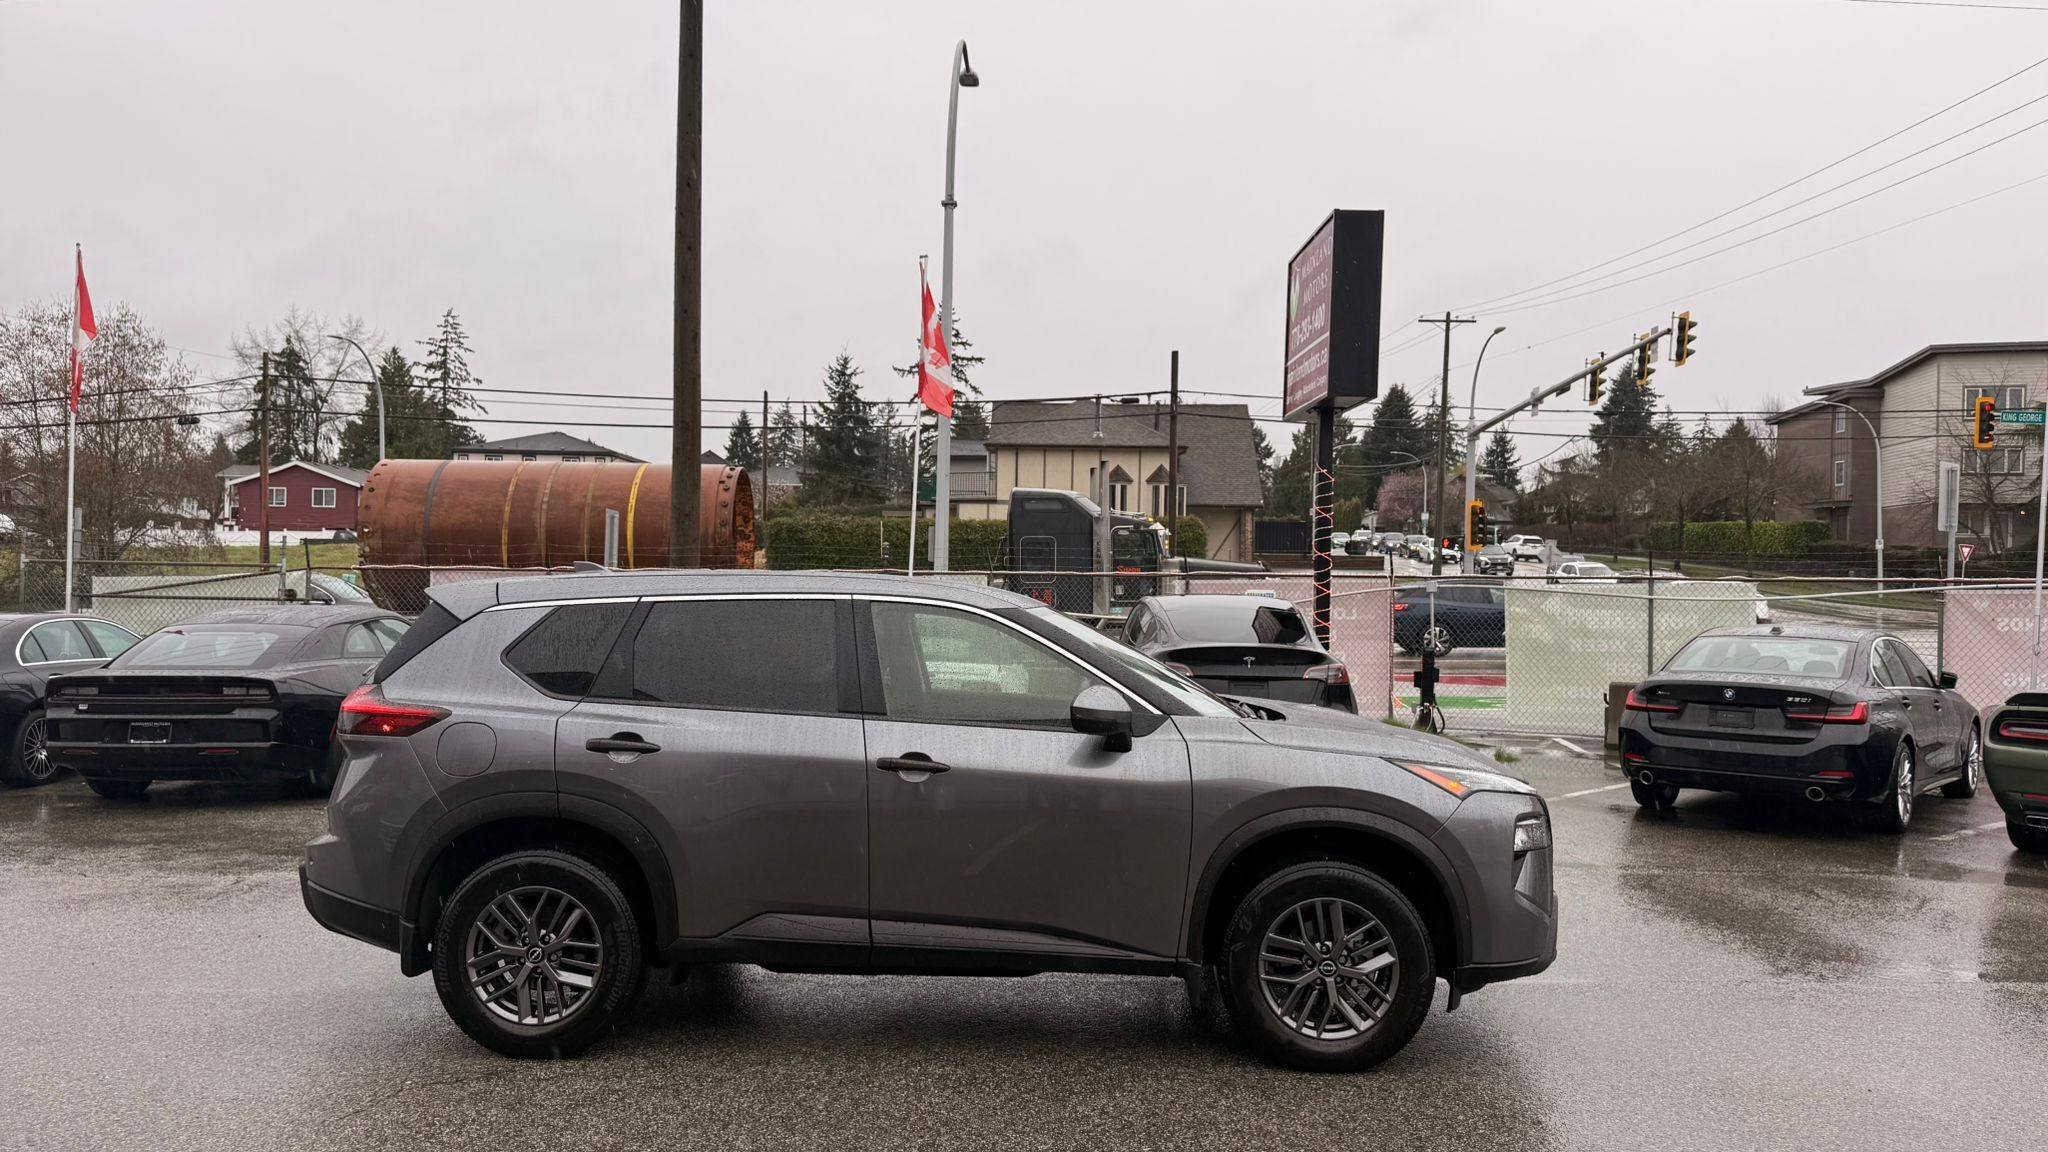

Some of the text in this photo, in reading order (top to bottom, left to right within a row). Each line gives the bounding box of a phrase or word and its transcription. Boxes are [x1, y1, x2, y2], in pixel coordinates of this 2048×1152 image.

[1301, 236, 1333, 279] MAINLAND
[1303, 269, 1327, 304] MOTORS
[2002, 413, 2043, 422] KING GEORGE
